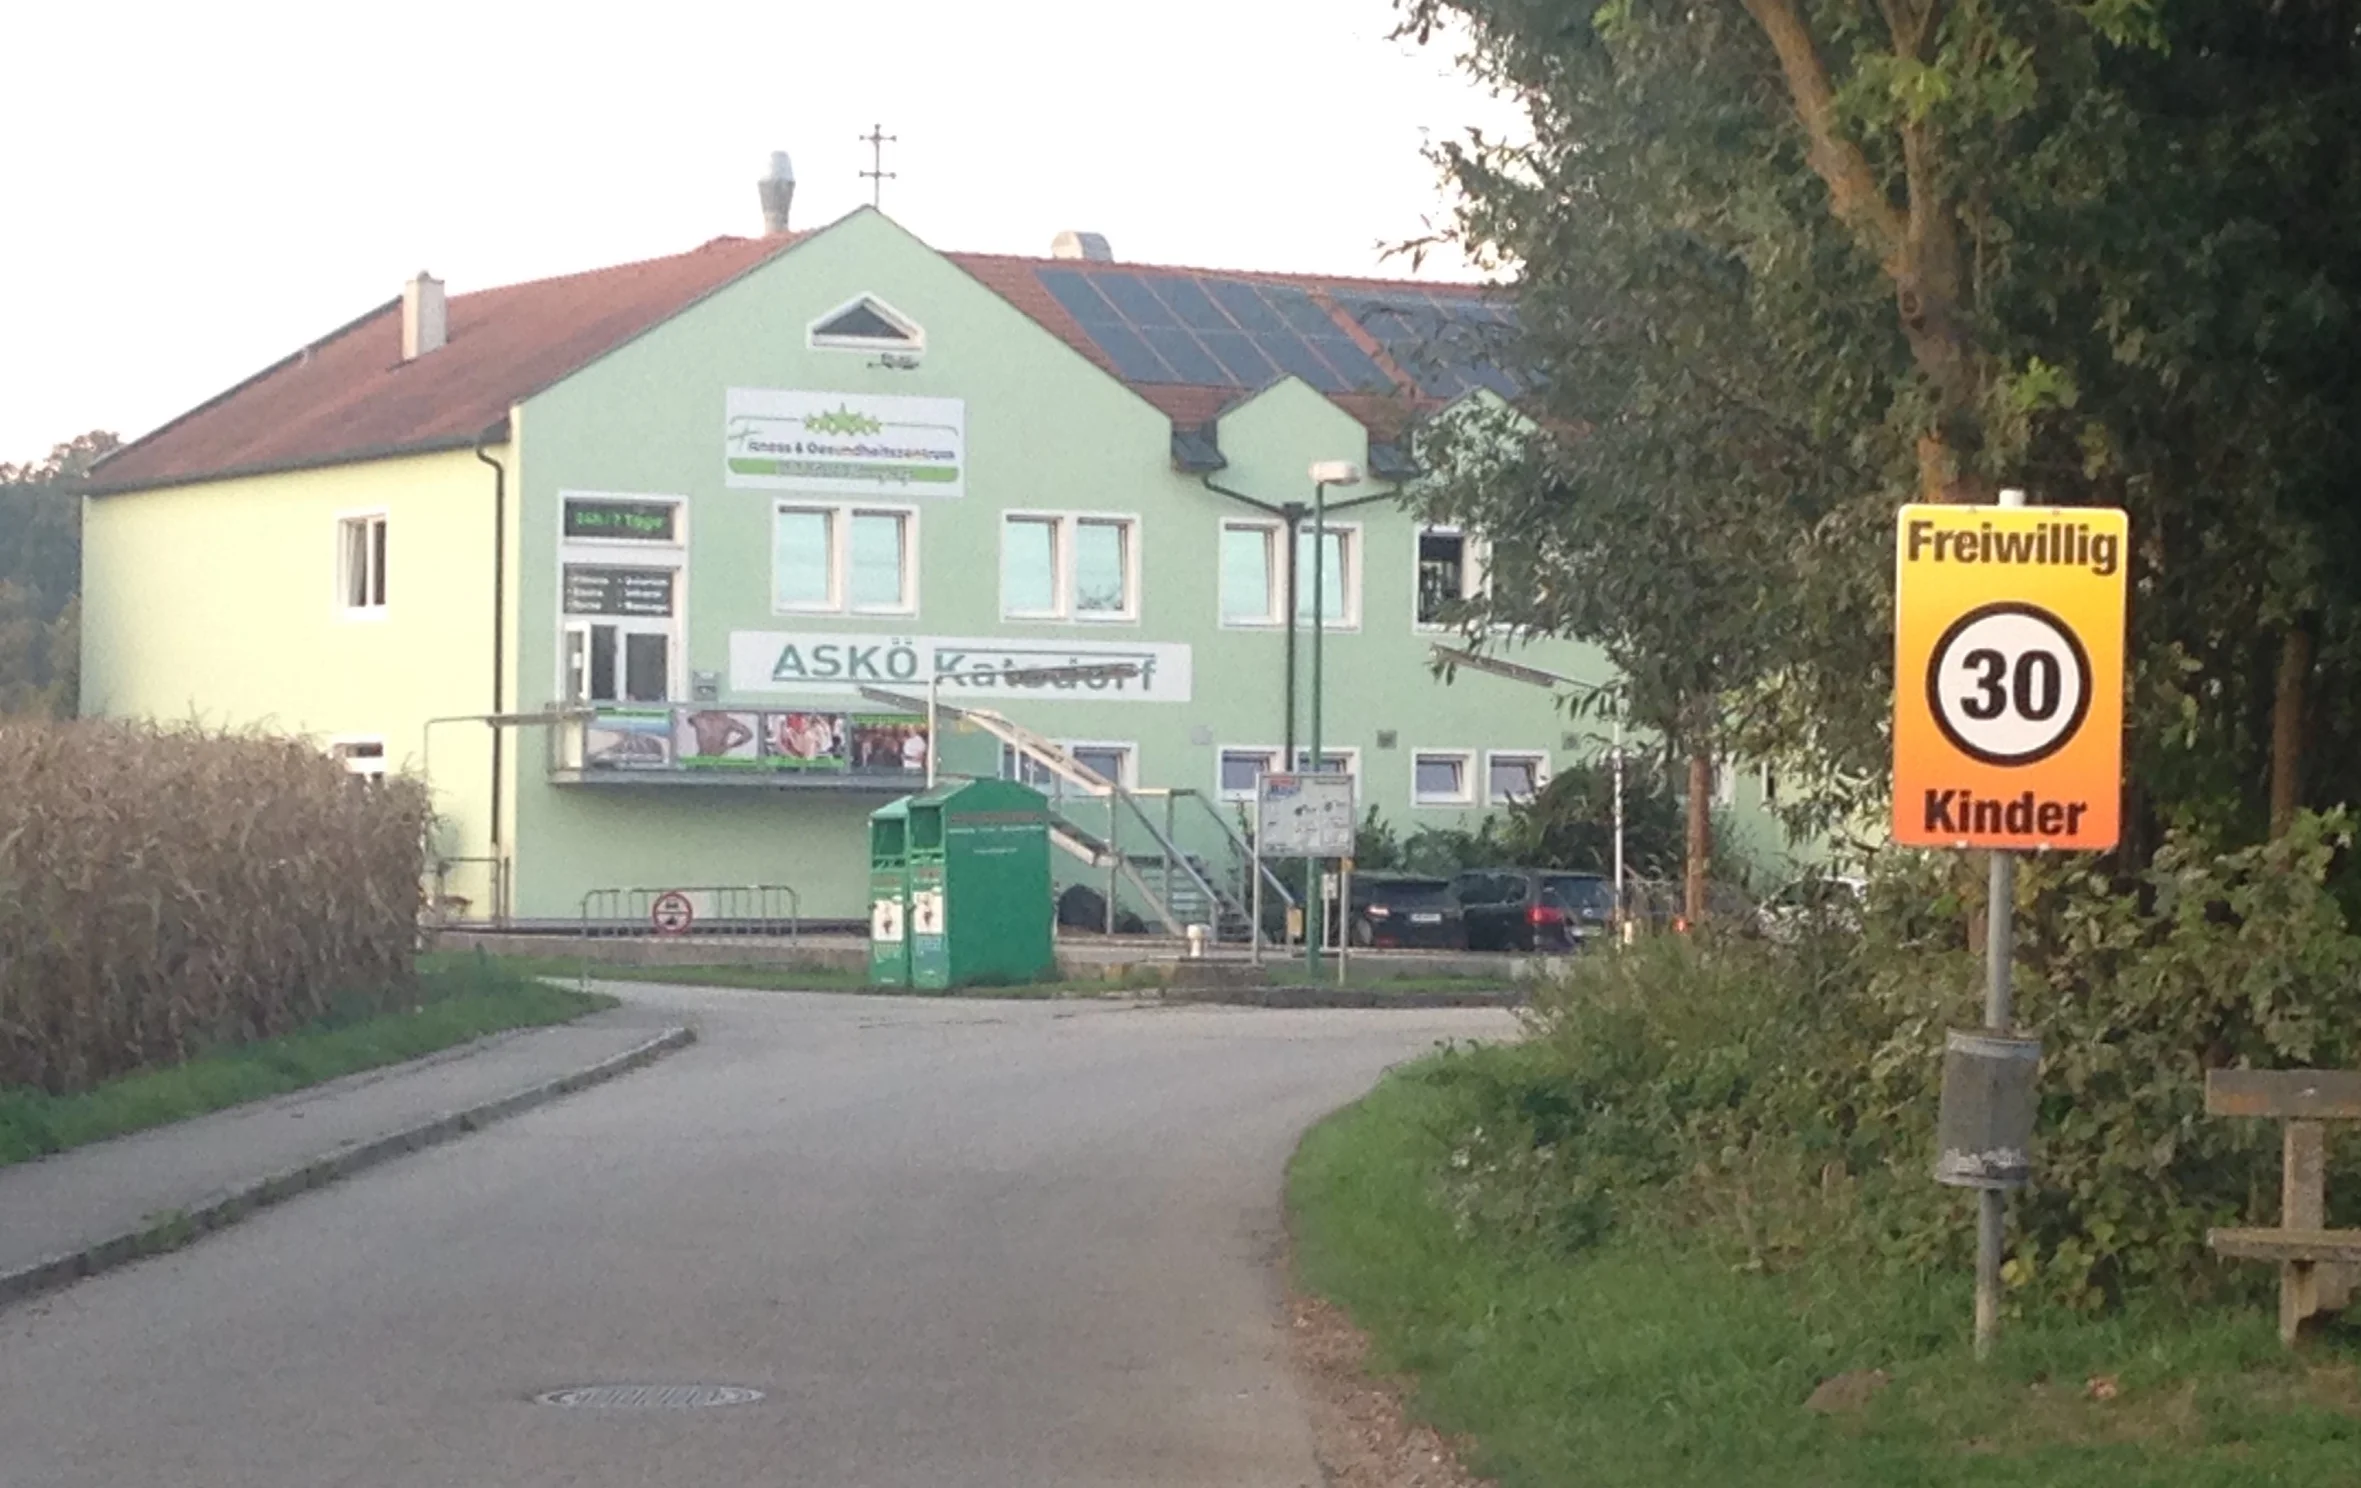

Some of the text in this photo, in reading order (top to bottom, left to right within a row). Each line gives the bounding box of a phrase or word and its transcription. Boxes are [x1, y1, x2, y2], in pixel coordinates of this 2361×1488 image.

[1907, 519, 2118, 576] Freiwillig
[773, 637, 918, 679] ASKÖ
[1960, 648, 2062, 721] 30
[1924, 789, 2087, 835] Kinder
